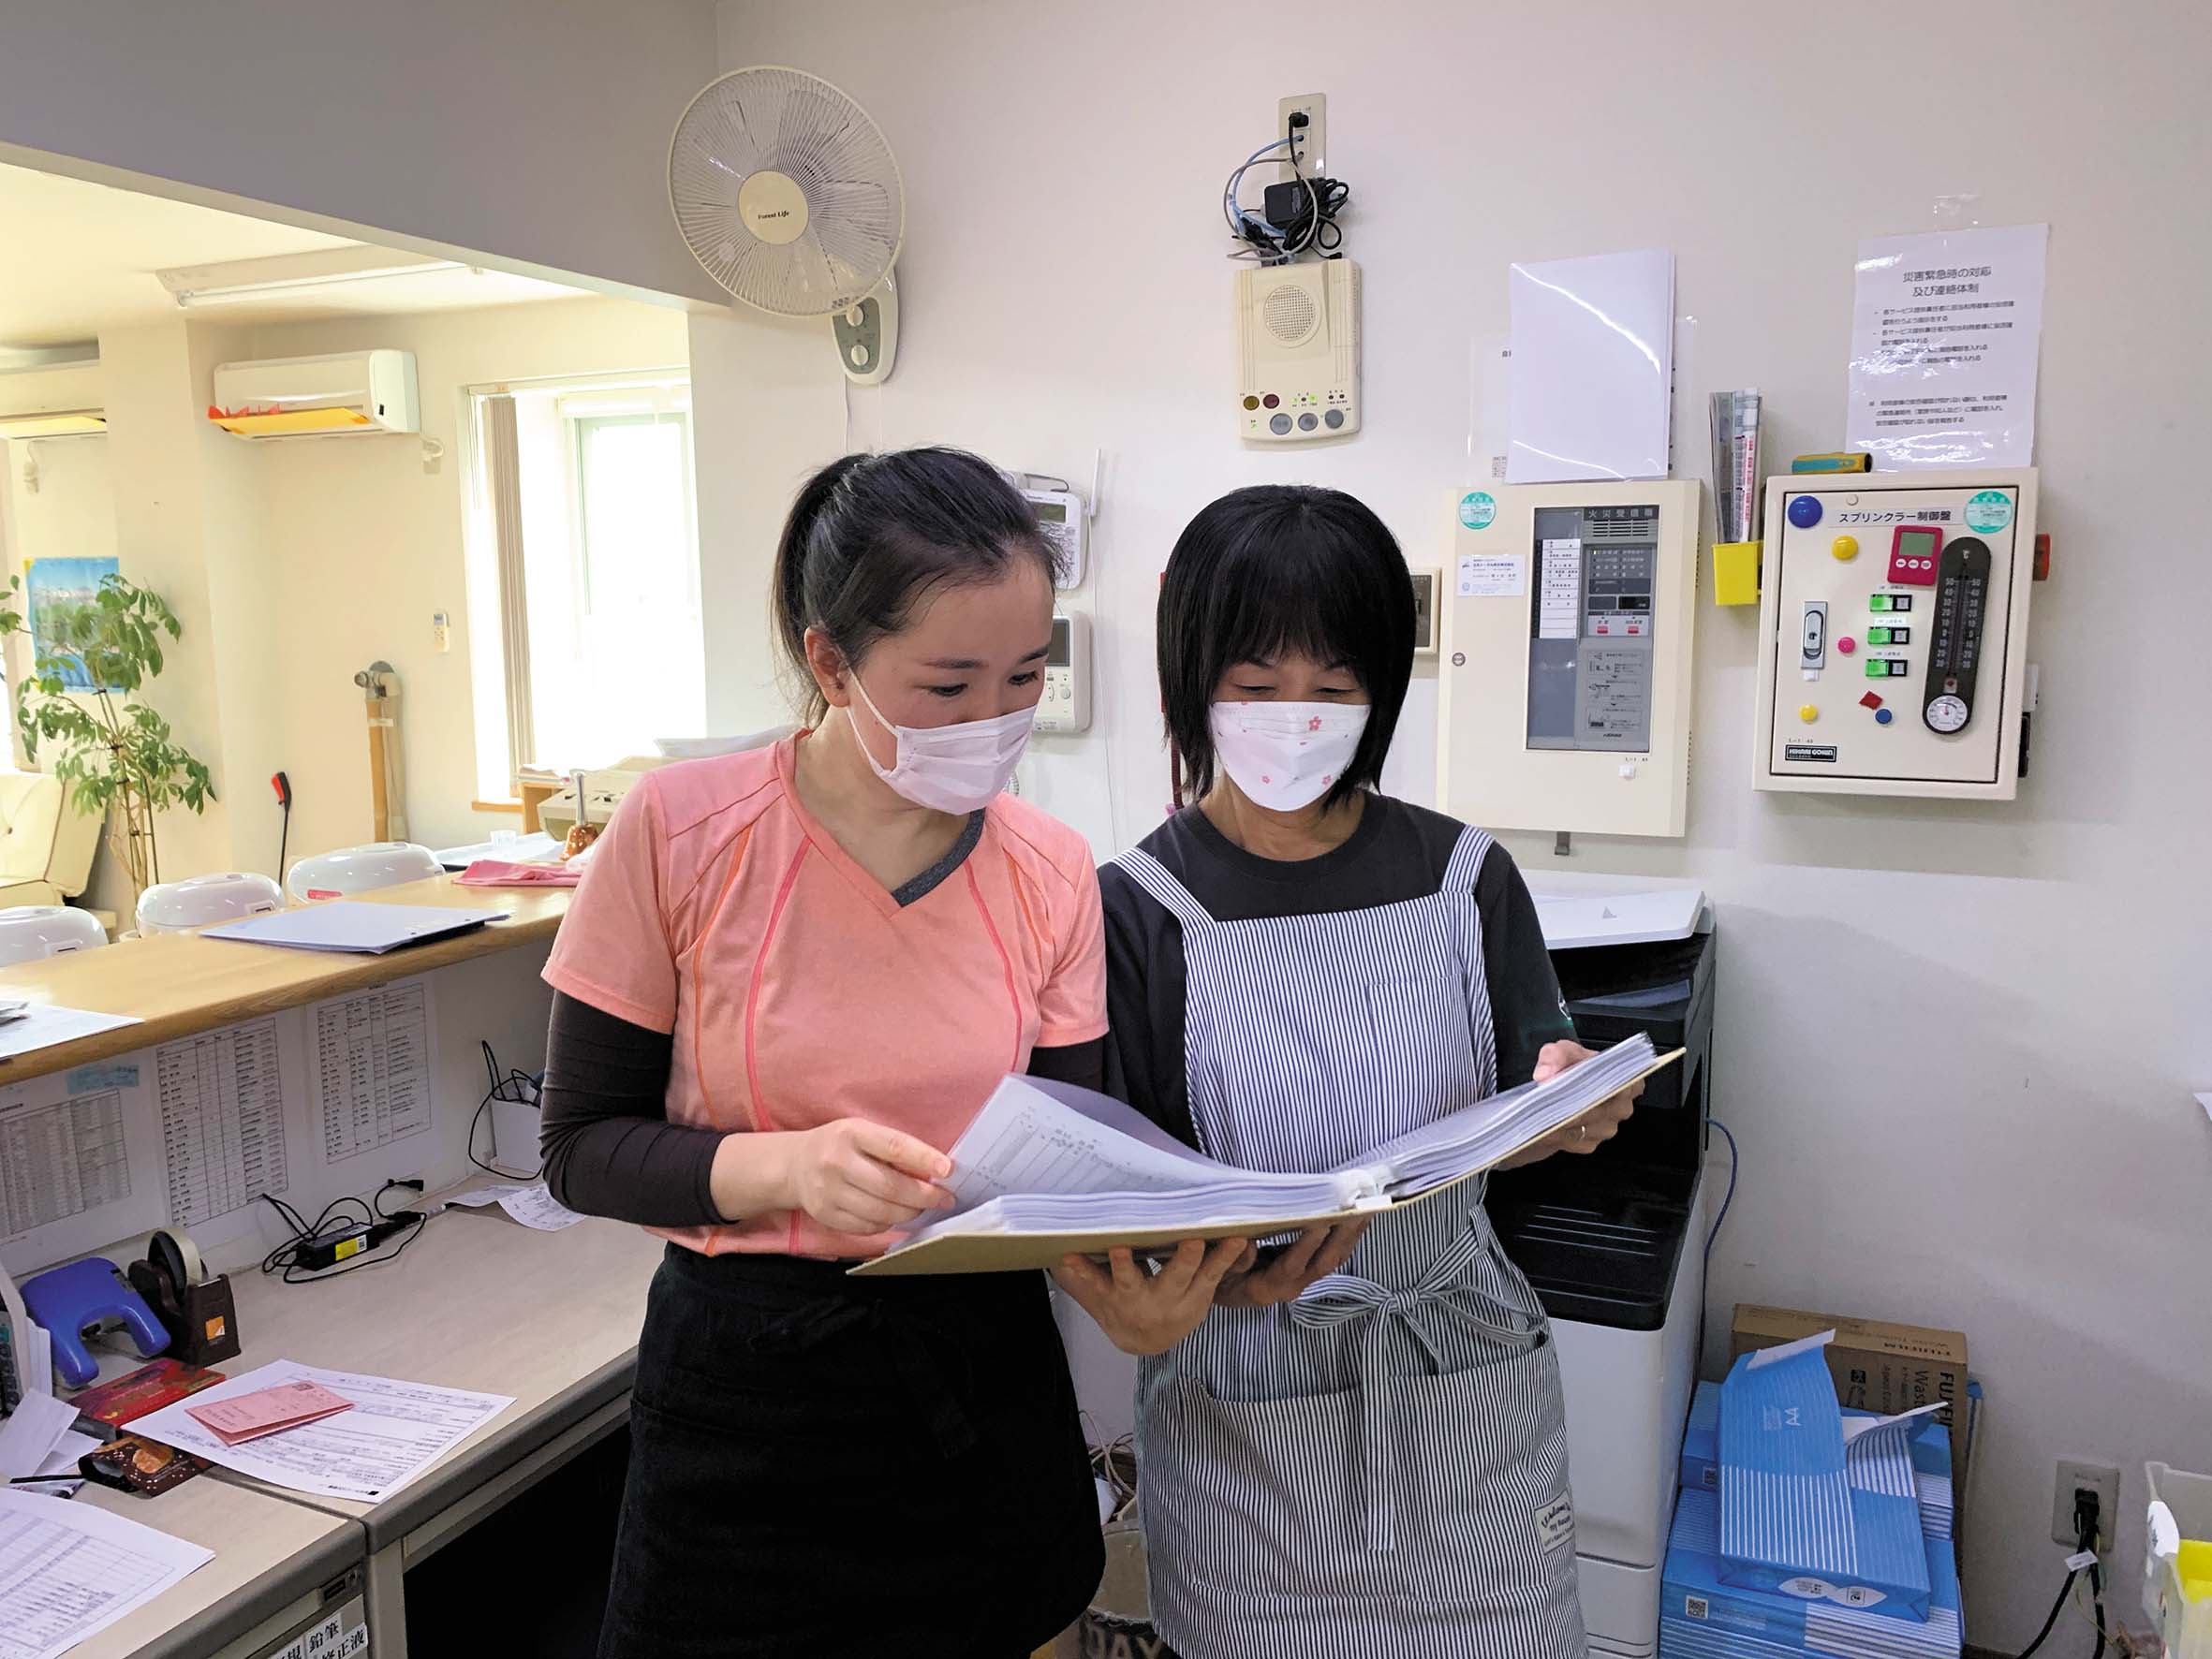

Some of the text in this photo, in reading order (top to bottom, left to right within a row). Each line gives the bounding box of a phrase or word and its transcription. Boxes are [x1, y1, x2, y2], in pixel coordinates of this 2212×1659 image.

[777, 210, 789, 218] Life
[1903, 266, 1992, 283] 災害緊急時の対応
[1911, 283, 1979, 298] 及び連絡体制
[1838, 511, 1952, 523] スプリンクラー制御盤
[1939, 1372, 1955, 1440] FUJFI
